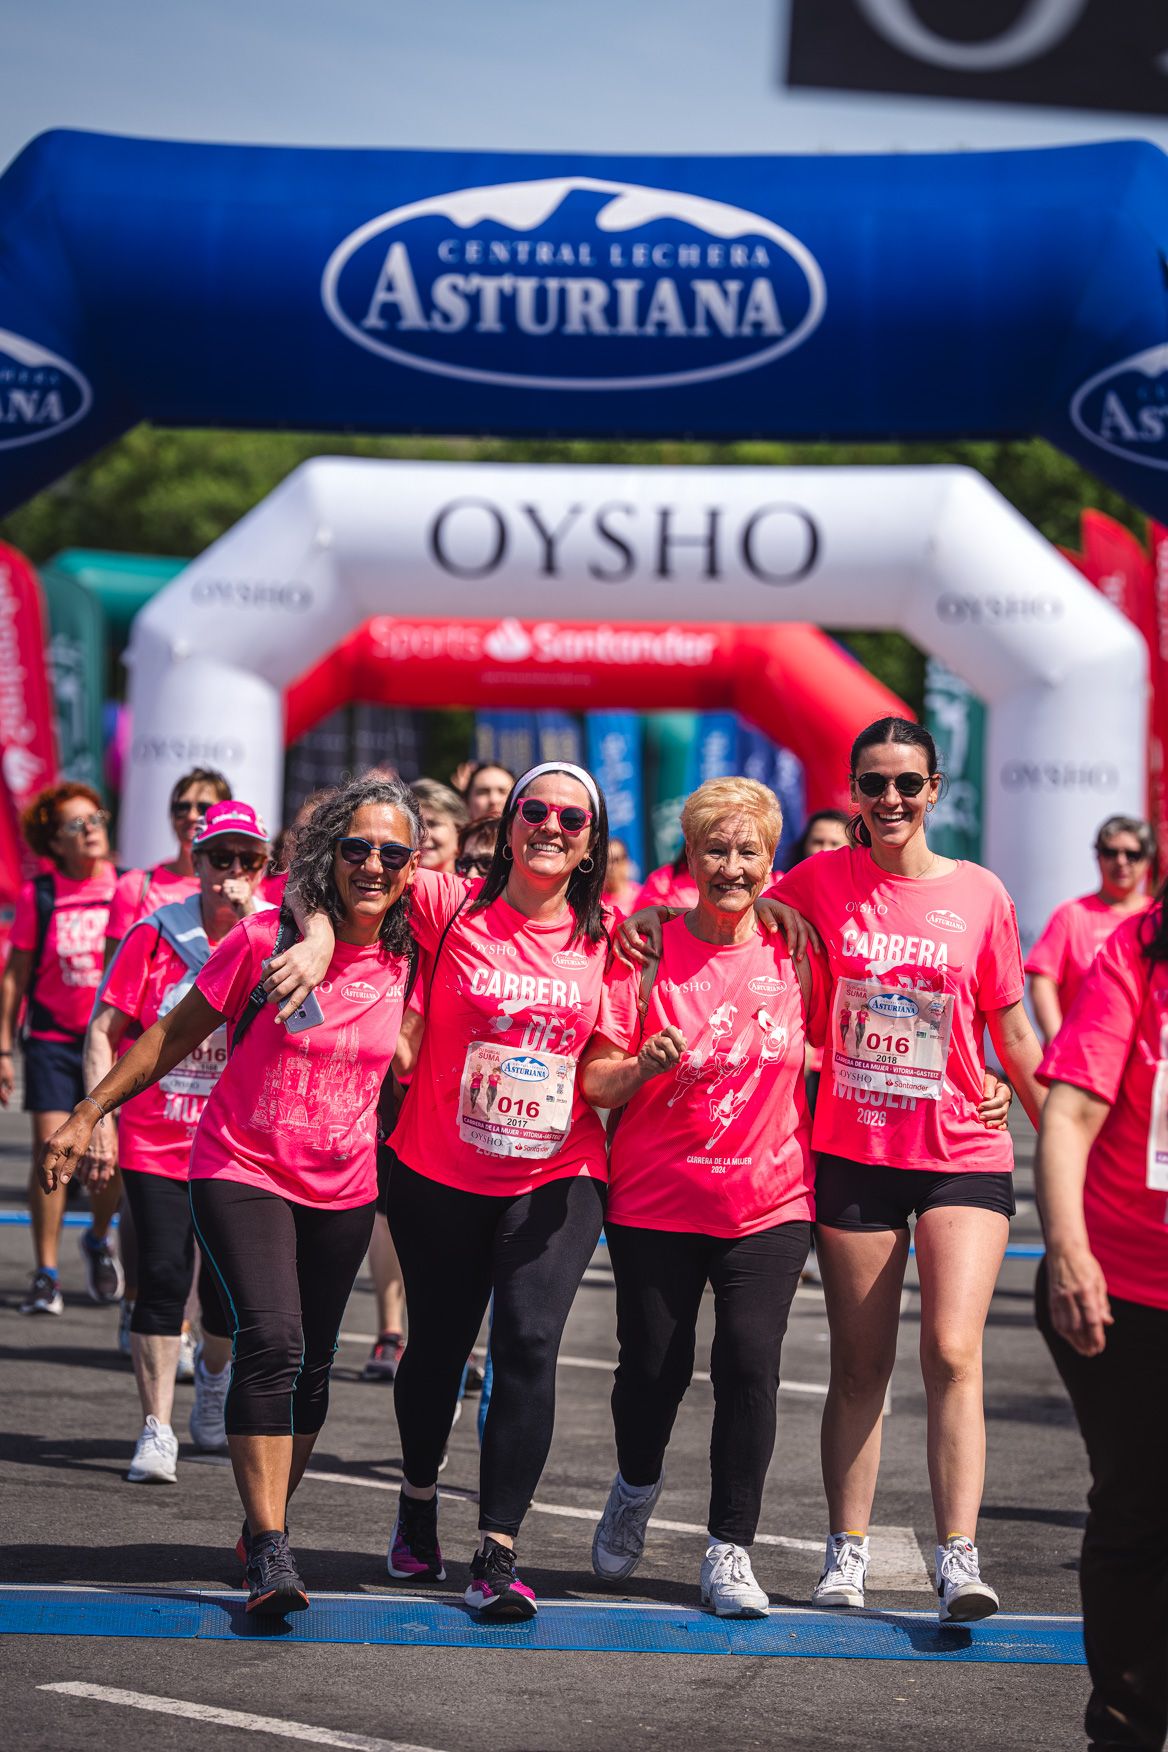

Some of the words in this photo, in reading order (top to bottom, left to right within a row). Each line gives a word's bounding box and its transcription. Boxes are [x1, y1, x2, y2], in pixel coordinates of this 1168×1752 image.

[437, 238, 597, 266] CENTRAL
[609, 243, 771, 270] LECHERA
[361, 241, 786, 337] ASTURIANA
[427, 495, 824, 588] OYSHO
[369, 615, 485, 661] Sports
[533, 623, 716, 665] Santander
[845, 901, 888, 915] OYSHO
[929, 914, 964, 931] ASTURIANA
[471, 941, 517, 957] OYSHO
[842, 930, 948, 972] CARRERA
[470, 967, 582, 1010] CARRERA
[665, 981, 711, 993] OYSHO
[846, 989, 868, 999] SUMA
[871, 1000, 915, 1014] ASTURIANA
[866, 1033, 910, 1054] 016
[478, 1052, 500, 1062] SUMA
[876, 1054, 898, 1064] 2018
[504, 1062, 546, 1077] ASTURIANA
[870, 1063, 889, 1071] MUJER
[840, 1069, 872, 1083] OYSHO
[894, 1080, 928, 1091] Santander
[497, 1096, 541, 1118] 016
[506, 1118, 528, 1128] 2017
[857, 1108, 887, 1127] 2026
[463, 1117, 484, 1129] CARRERA
[501, 1127, 519, 1136] MUJER
[471, 1131, 503, 1147] OYSHO
[686, 1155, 713, 1165] CARRERA
[723, 1157, 731, 1165] LA
[731, 1157, 752, 1166] MUJER
[711, 1165, 726, 1174] 2024
